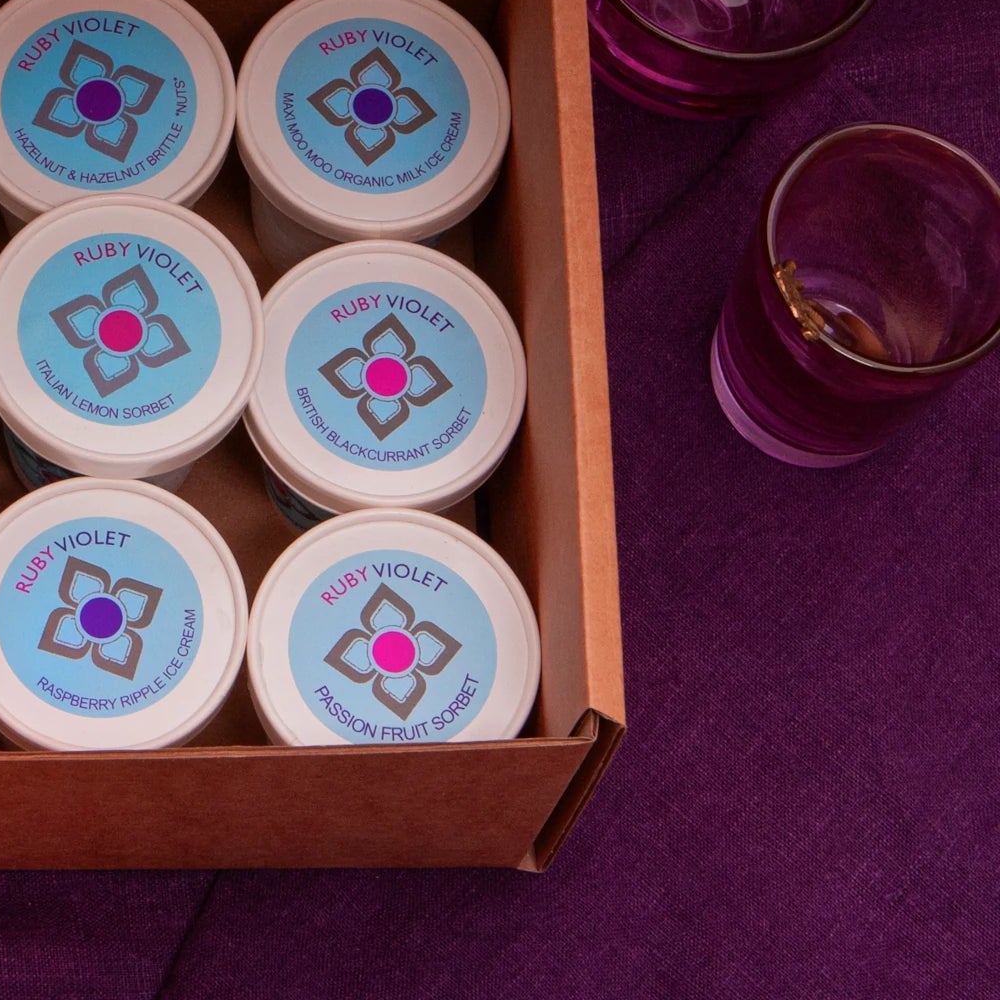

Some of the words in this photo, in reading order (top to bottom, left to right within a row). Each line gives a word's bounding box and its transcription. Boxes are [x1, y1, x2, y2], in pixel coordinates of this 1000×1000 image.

[17, 29, 61, 72] RUBY
[62, 18, 140, 37] VIOLET
[318, 29, 368, 55] RUBY
[372, 30, 438, 67] VIOLET
[283, 92, 295, 122] MAXI
[14, 128, 67, 175] HAZELNUT
[67, 169, 76, 181] &
[80, 162, 147, 184] HAZELNUT
[146, 122, 183, 166] BRITTLE
[287, 122, 309, 150] MOO
[440, 112, 462, 153] CREAM
[304, 149, 333, 174] MOO
[334, 168, 394, 187] ORGANIC
[396, 164, 426, 184] MILK
[425, 153, 445, 170] ICE
[73, 242, 132, 267] RUBY
[136, 244, 203, 294] VIOLET
[330, 294, 381, 324] RUBY
[386, 295, 455, 333] VIOLET
[36, 359, 72, 400] ITALIAN
[72, 396, 119, 419] LEMON
[122, 393, 175, 419] SORBET
[297, 387, 327, 434] BRITISH
[326, 431, 431, 462] BLACKCURRANT
[432, 407, 473, 450] SORBET
[15, 545, 55, 594] RUBY
[54, 530, 131, 552] VIOLET
[320, 566, 369, 606] RUBY
[372, 563, 448, 593] VIOLET
[37, 676, 116, 710] RASPBERRY
[120, 677, 167, 708] RIPPLE
[162, 658, 183, 680] ICE
[177, 609, 195, 658] CREAM
[314, 685, 377, 738] PASSION
[381, 722, 429, 741] FRUIT
[431, 673, 480, 731] SORBET
